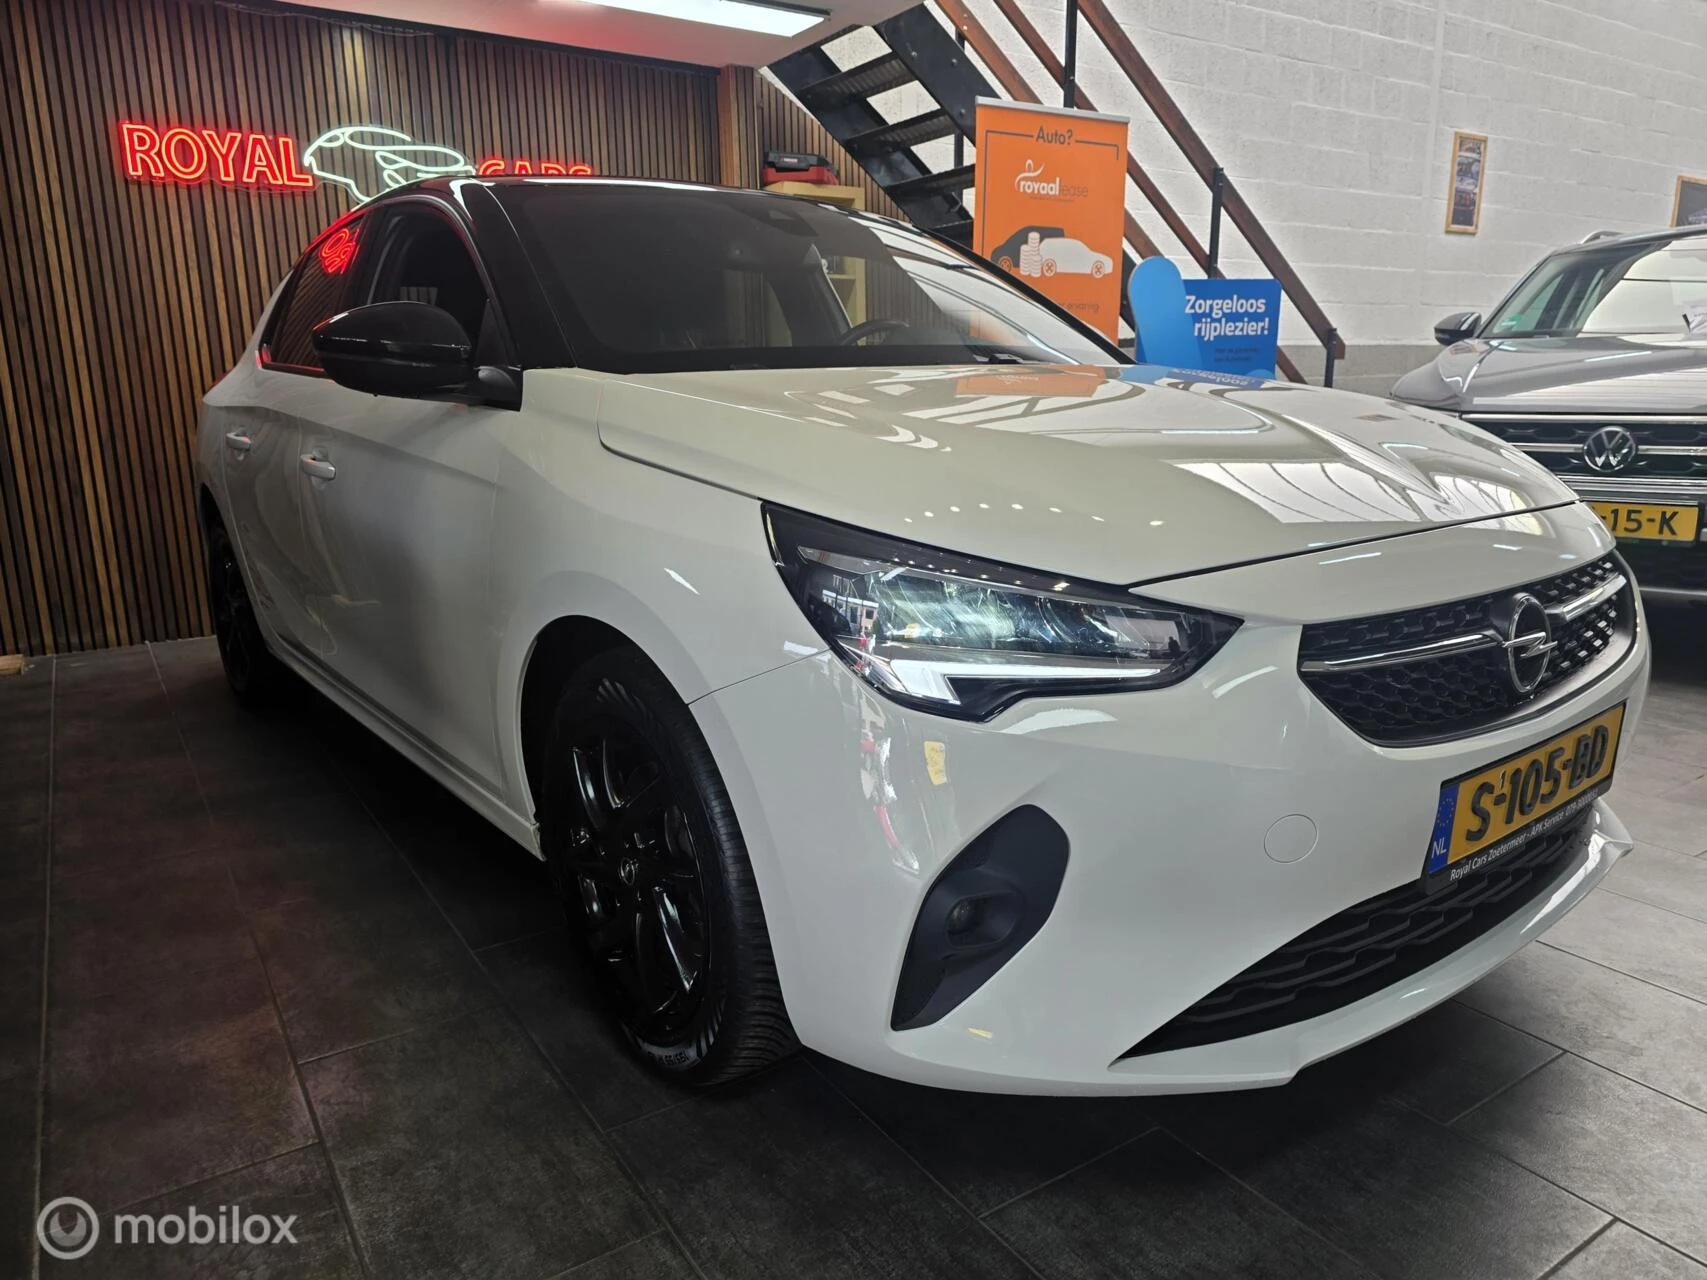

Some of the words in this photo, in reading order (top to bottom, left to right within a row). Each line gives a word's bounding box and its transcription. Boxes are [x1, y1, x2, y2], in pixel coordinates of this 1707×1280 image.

[1035, 125, 1074, 146] Auto?
[122, 123, 313, 187] ROYAL
[1184, 294, 1267, 319] Zorgeloos
[1193, 317, 1270, 341] rijplezier!
[1599, 508, 1679, 536] -15-K
[1431, 836, 1447, 859] NL
[1450, 860, 1471, 881] Royal
[1472, 853, 1487, 870] Cars
[1488, 832, 1527, 862] Zoetermeer
